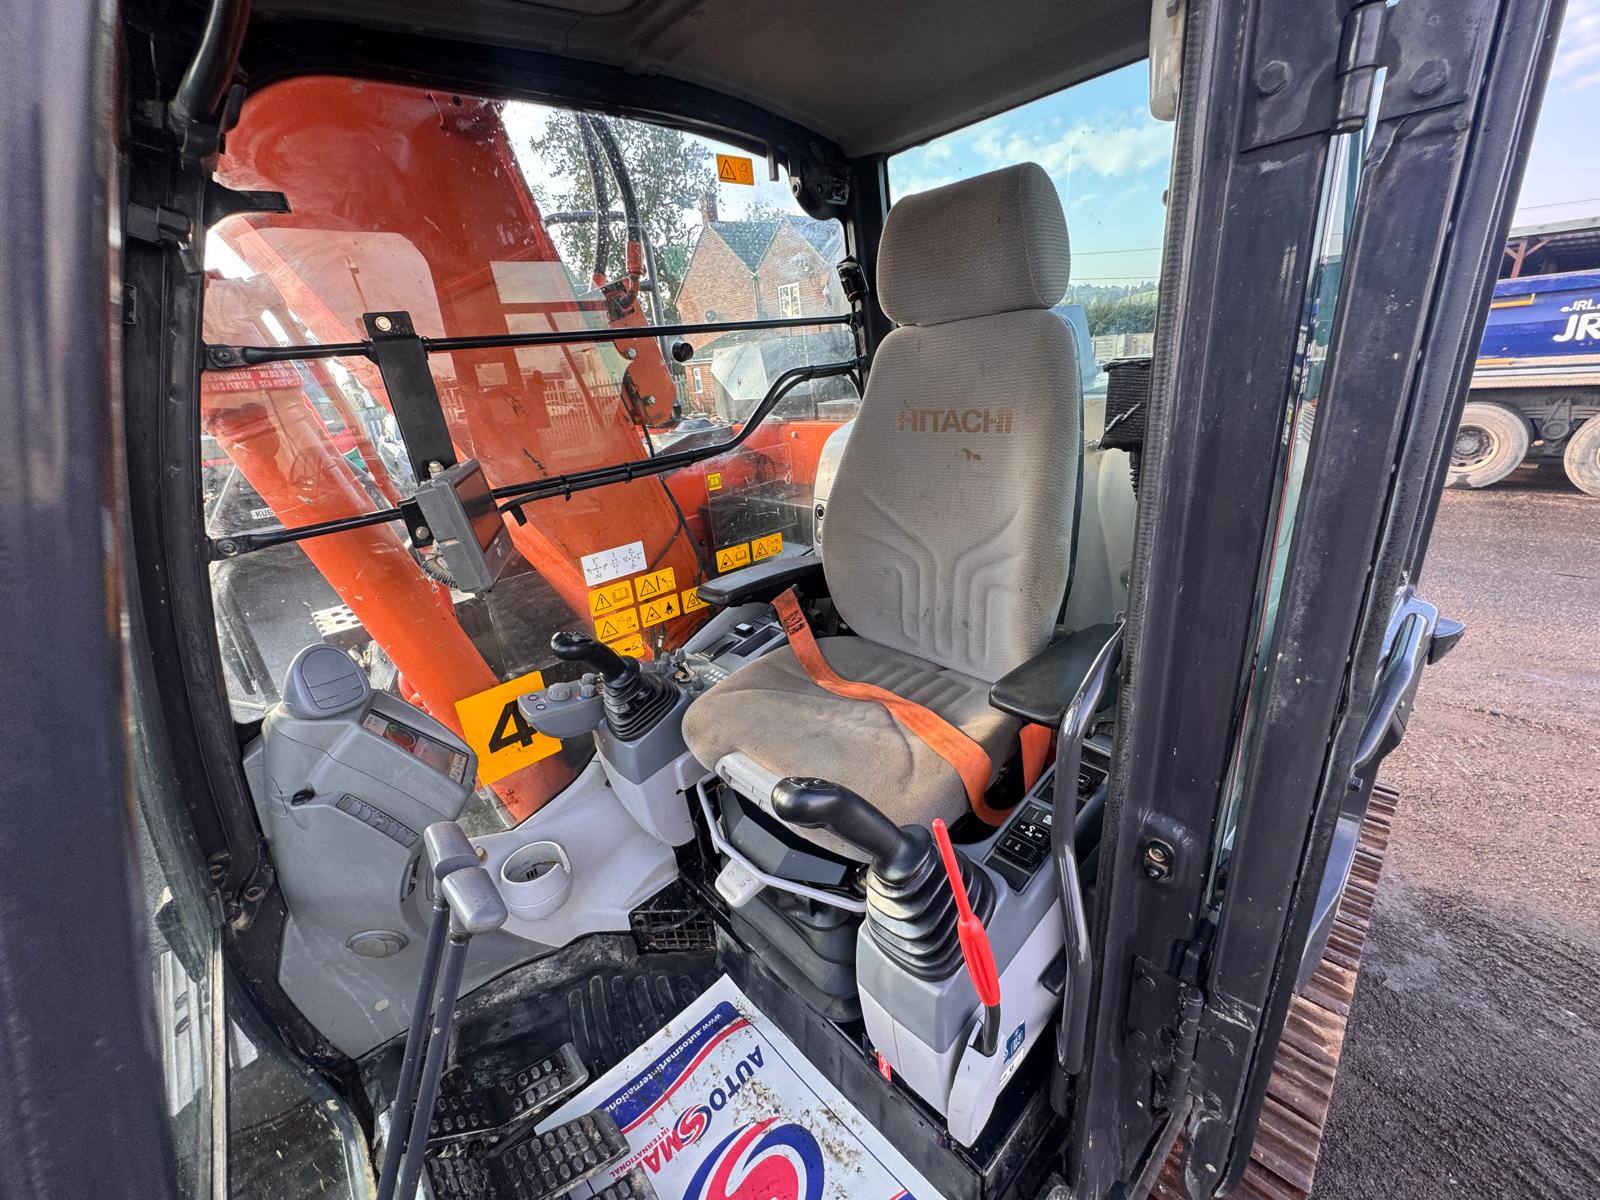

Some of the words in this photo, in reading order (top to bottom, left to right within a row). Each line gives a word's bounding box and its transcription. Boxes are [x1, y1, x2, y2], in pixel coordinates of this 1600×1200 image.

[897, 408, 1014, 433] HITACHI
[488, 699, 538, 754] 4
[614, 1044, 764, 1182] AUTOSMA
[609, 1127, 669, 1177] INTERNATIONAL
